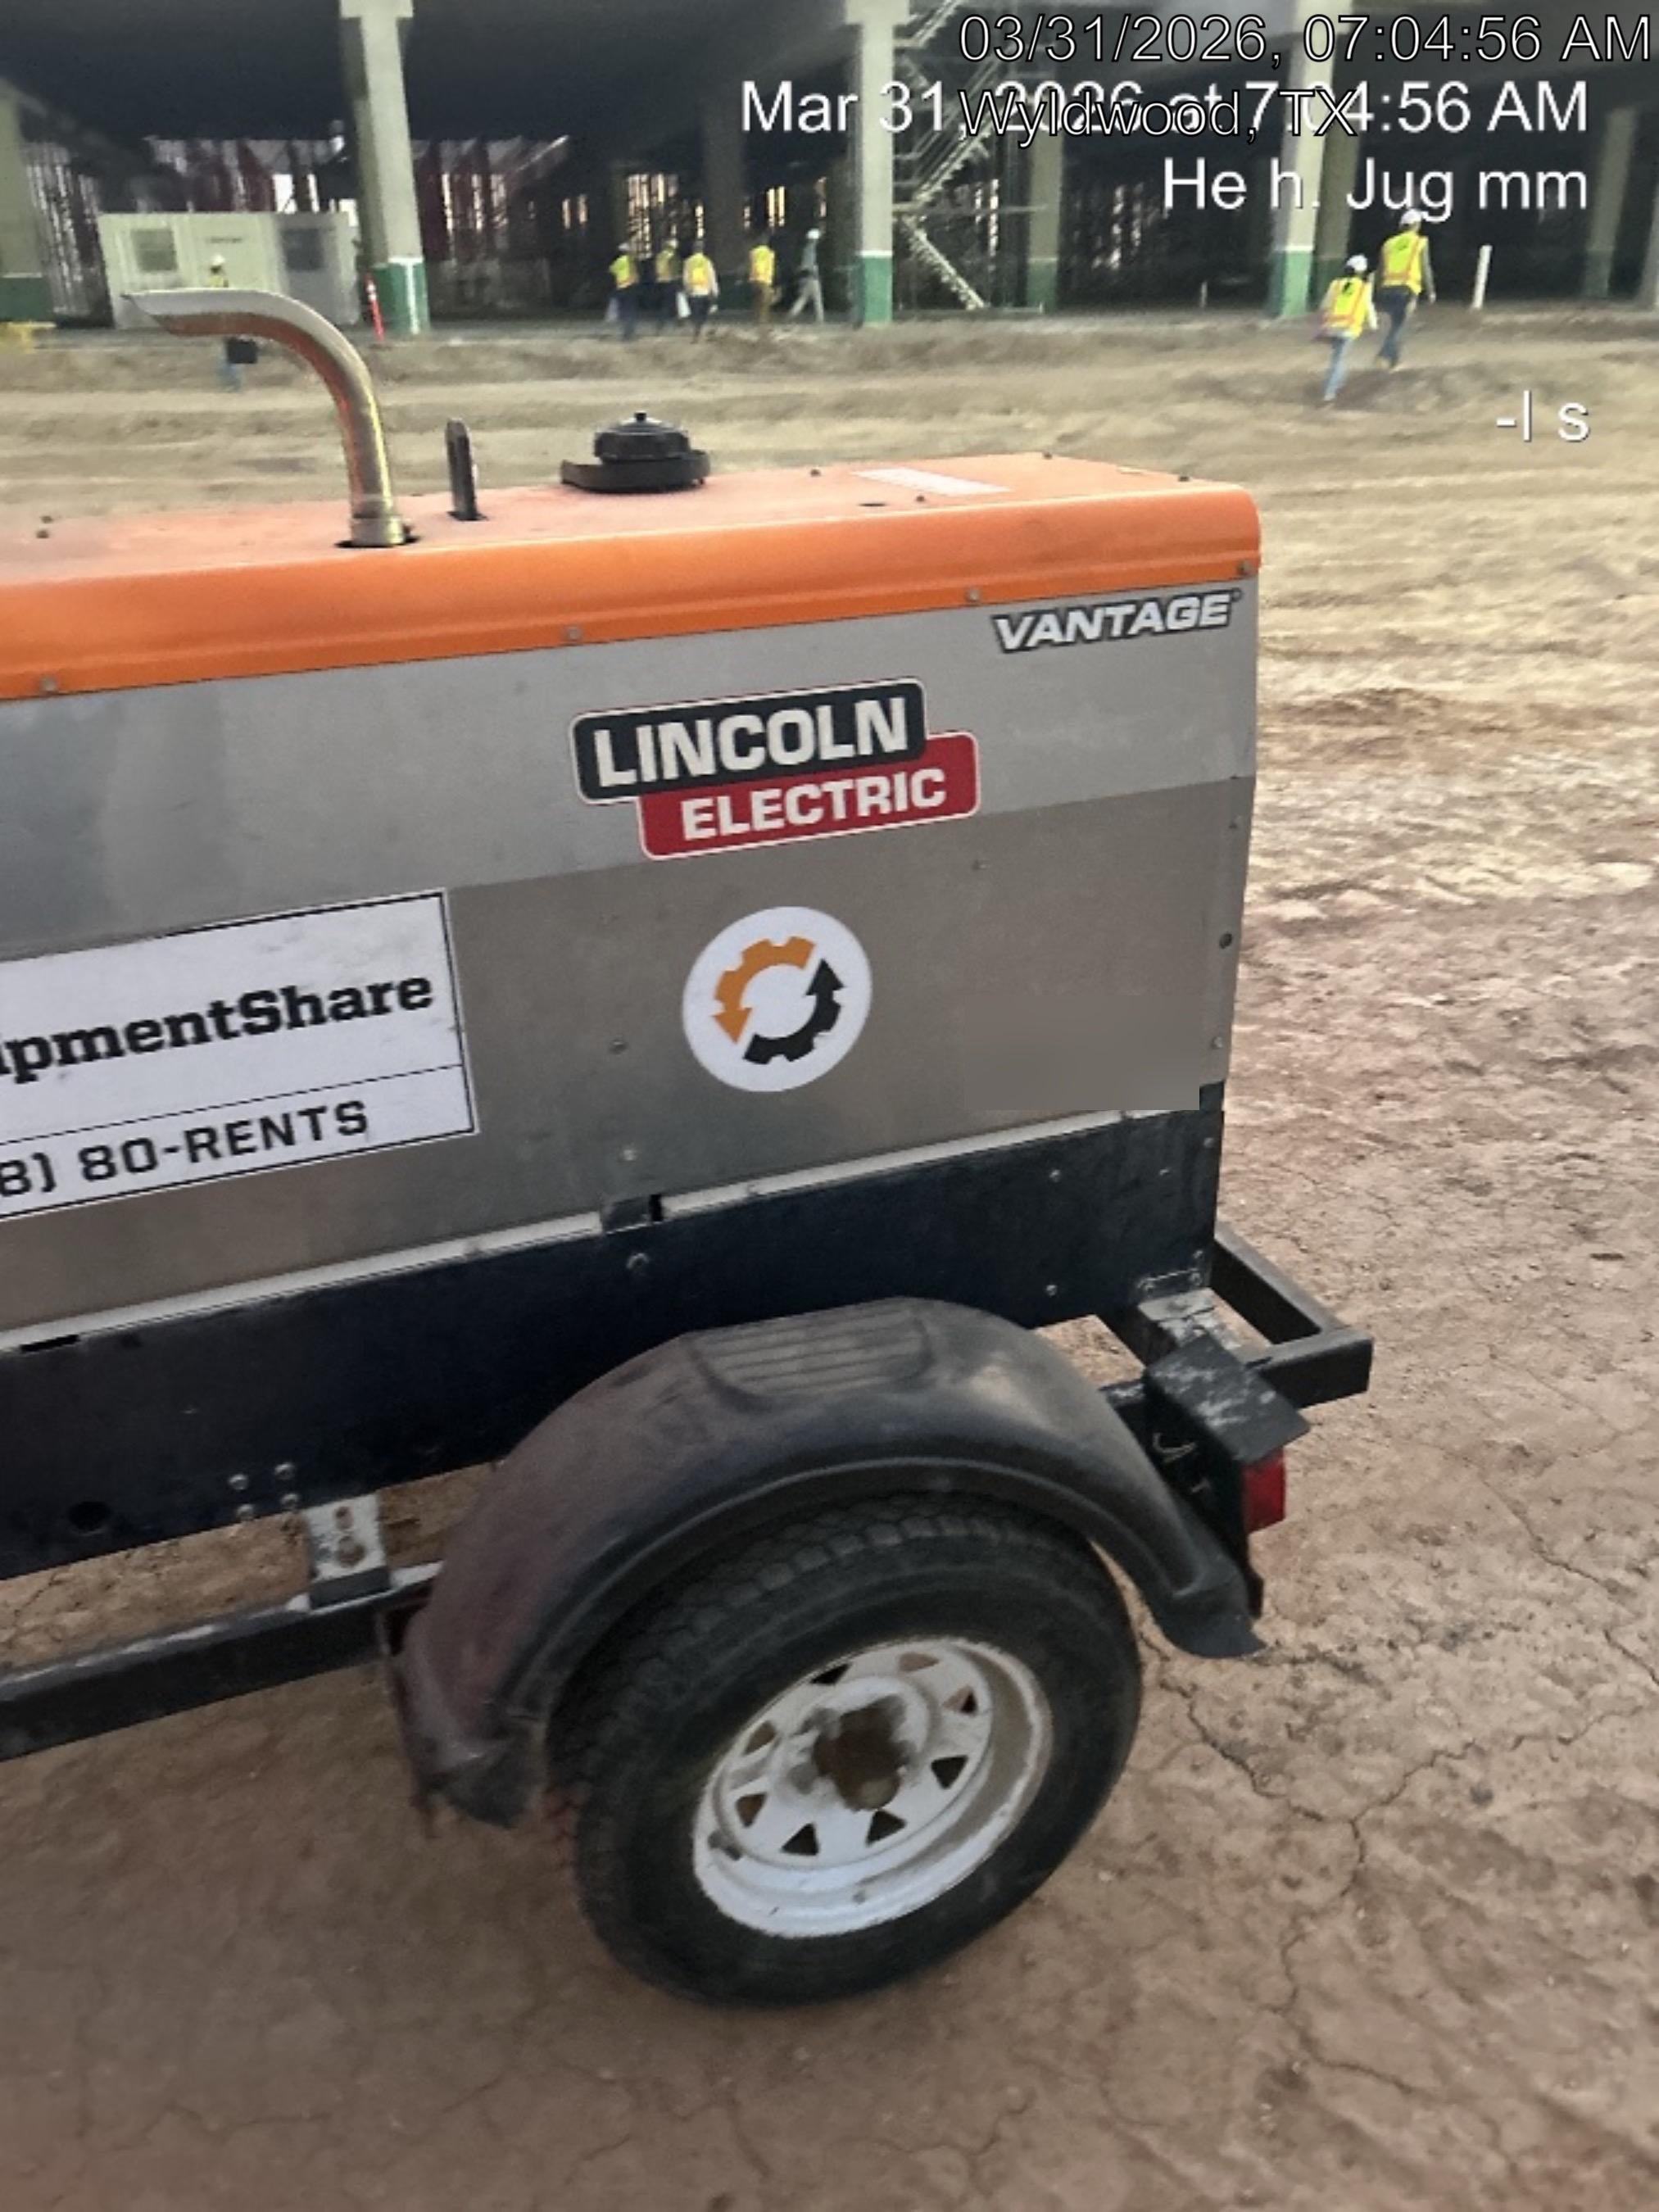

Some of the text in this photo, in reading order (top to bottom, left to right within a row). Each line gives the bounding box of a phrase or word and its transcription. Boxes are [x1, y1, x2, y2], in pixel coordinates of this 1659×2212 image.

[993, 591, 1231, 652] VANTAGE
[592, 696, 909, 788] LINCOLN
[680, 768, 948, 842] ELECTRIC
[78, 1099, 369, 1182] 80-RENTS
